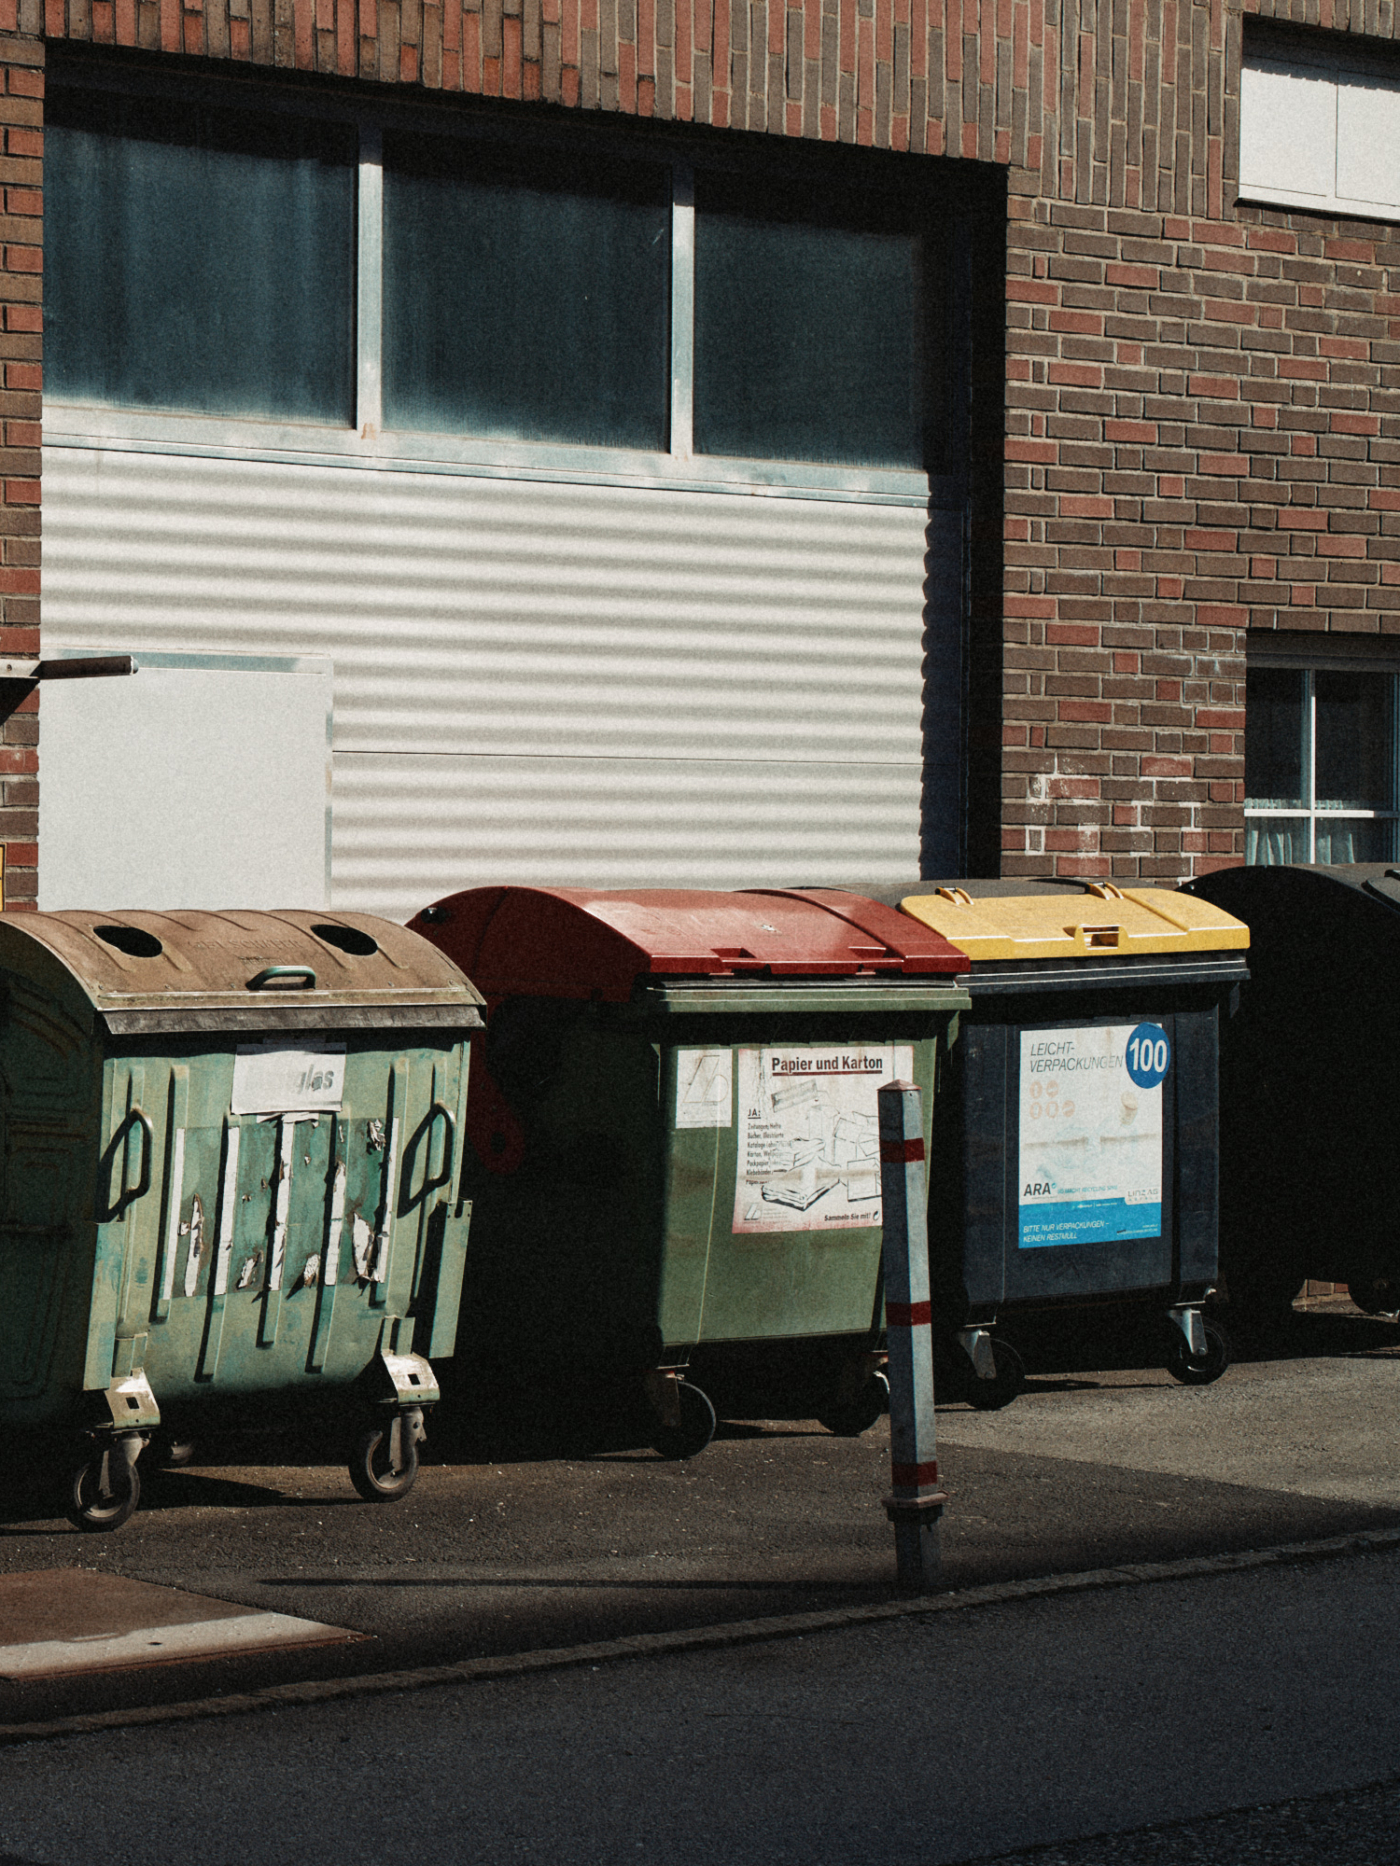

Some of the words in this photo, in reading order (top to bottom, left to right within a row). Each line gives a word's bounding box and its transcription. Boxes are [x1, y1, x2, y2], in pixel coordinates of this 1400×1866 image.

[1030, 1041, 1075, 1056] LEICHT-
[1129, 1037, 1167, 1073] 100
[772, 1057, 812, 1074] Papier
[816, 1056, 838, 1070] und
[842, 1055, 882, 1070] Karton
[1029, 1055, 1124, 1073] VERPACKUNGEN
[1023, 1182, 1051, 1197] ARA
